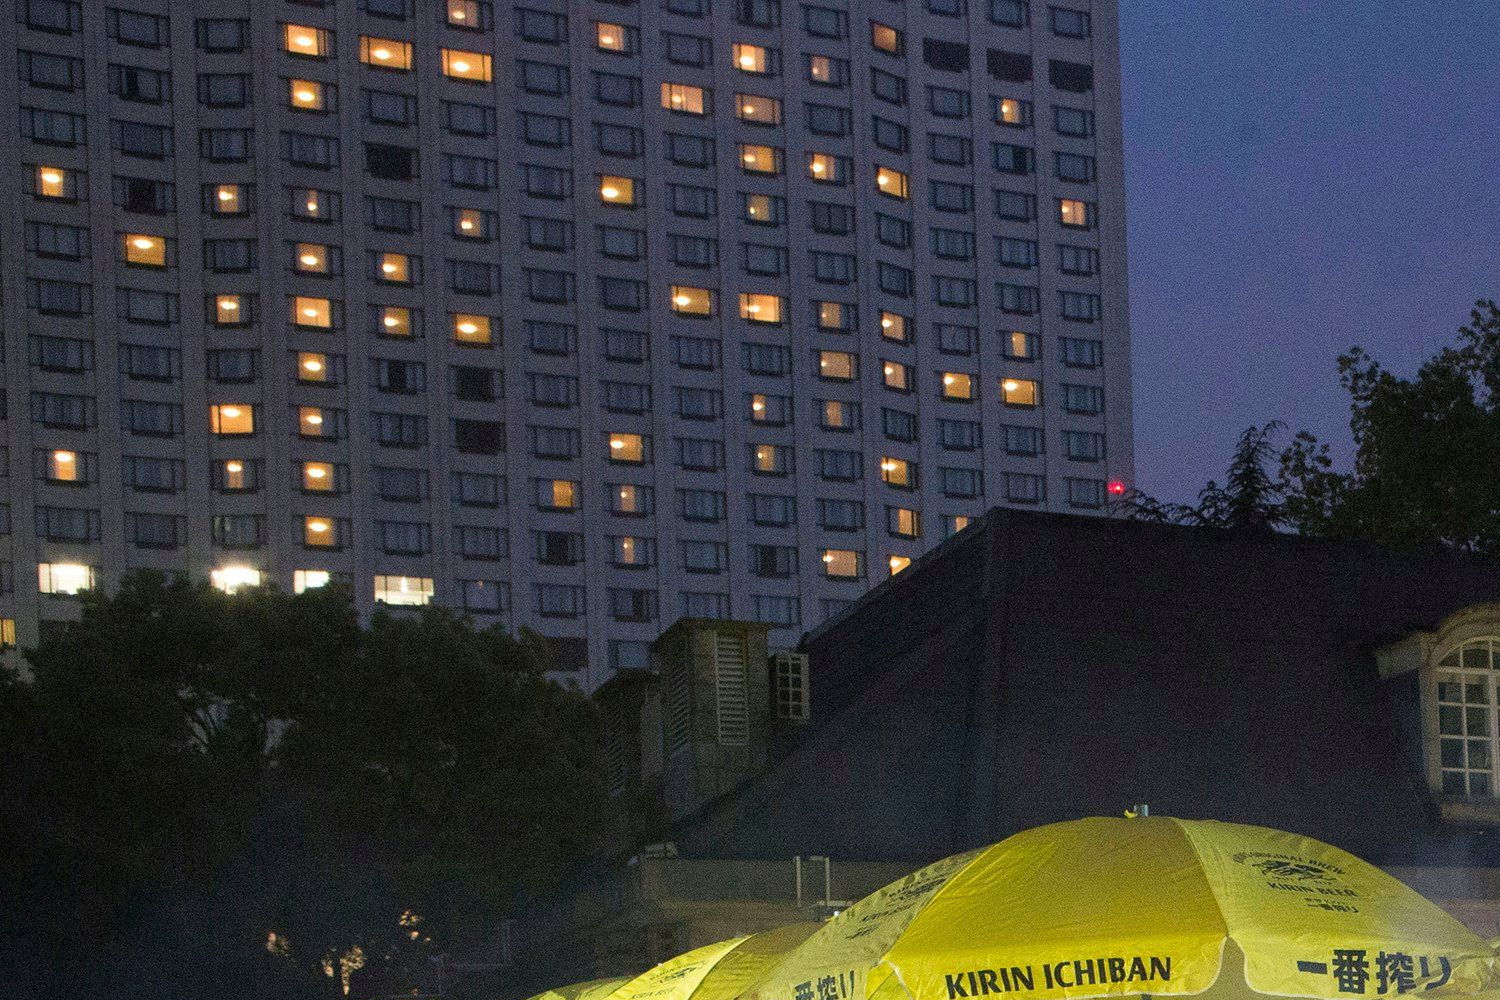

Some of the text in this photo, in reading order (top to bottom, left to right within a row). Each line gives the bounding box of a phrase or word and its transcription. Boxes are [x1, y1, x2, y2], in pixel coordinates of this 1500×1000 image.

[1266, 881, 1315, 893] KIRIN
[1316, 887, 1359, 897] BEER
[945, 956, 1172, 1000] KIRIN ICHIBAN
[1296, 949, 1452, 995] 一番搾り
